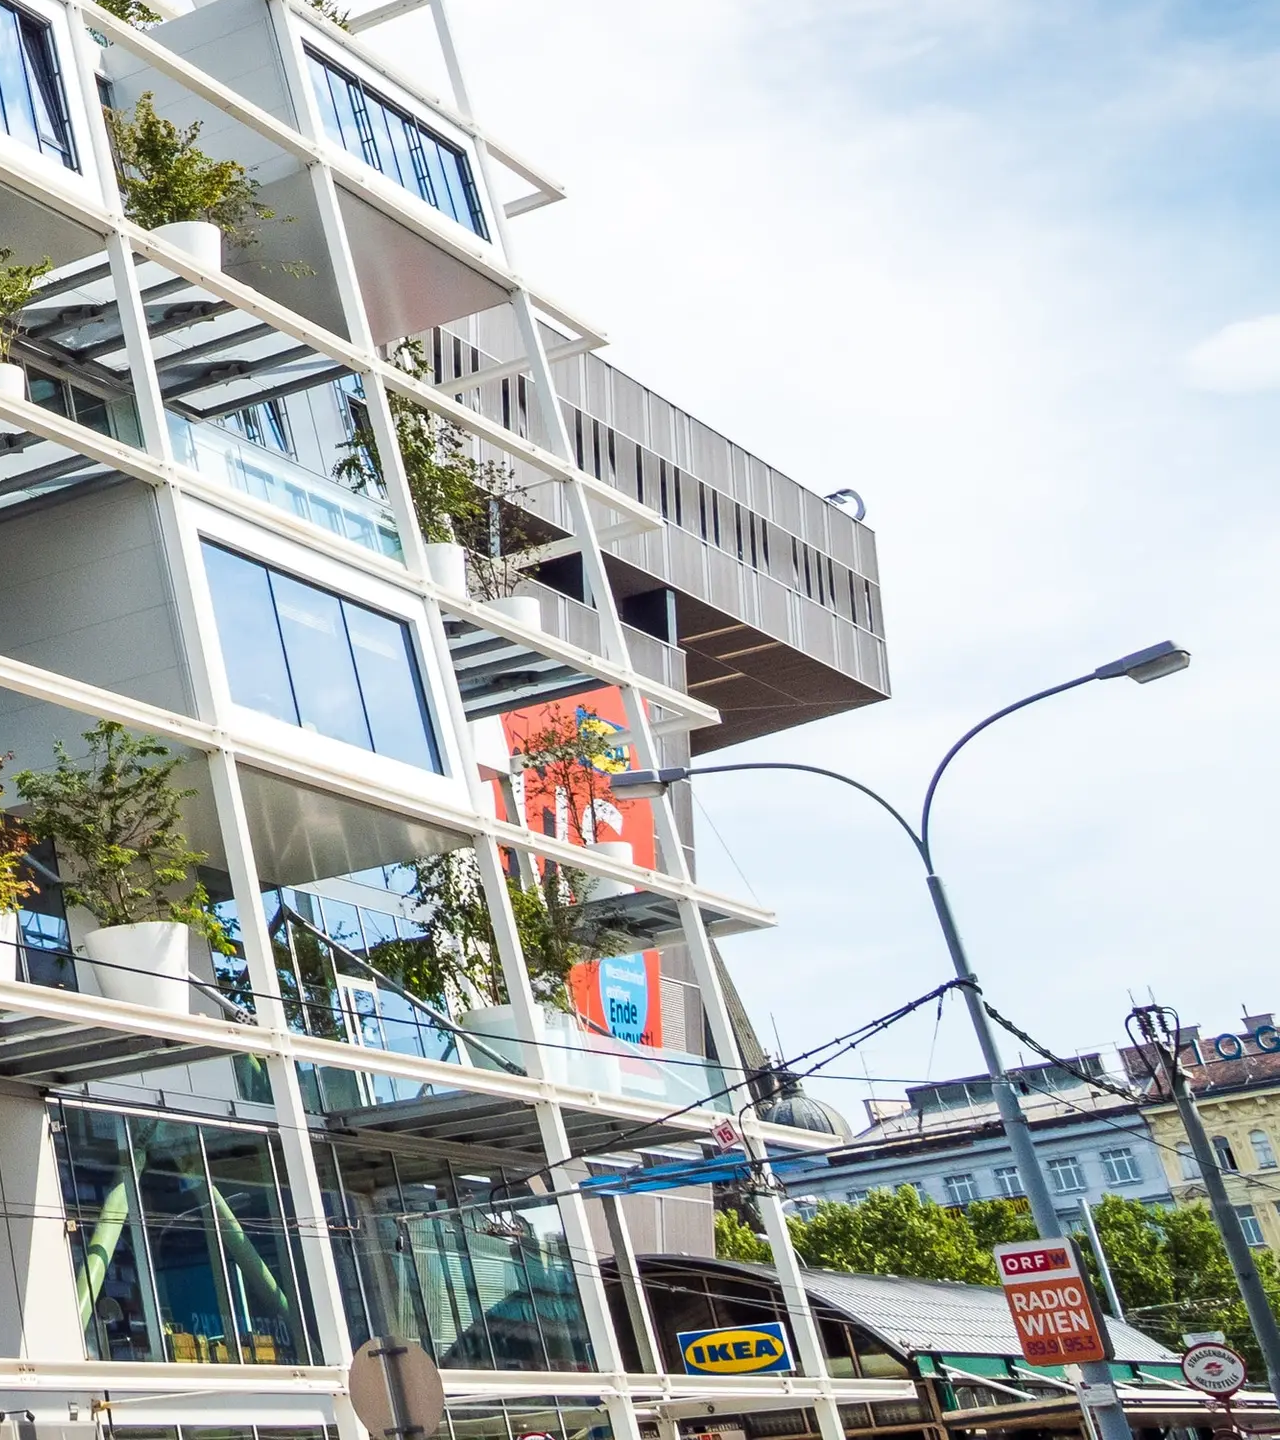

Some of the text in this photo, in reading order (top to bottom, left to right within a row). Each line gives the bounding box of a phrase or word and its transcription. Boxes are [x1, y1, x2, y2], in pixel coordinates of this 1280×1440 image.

[610, 998, 638, 1025] Ende
[717, 1127, 734, 1143] 15
[1005, 1255, 1045, 1271] ORF
[1011, 1286, 1082, 1312] RADIO
[1018, 1309, 1090, 1336] WIEN
[692, 1339, 778, 1363] IKEA
[1026, 1336, 1096, 1356] 89.9 95.3
[1187, 1349, 1237, 1369] STRASSENBAHN
[1194, 1372, 1240, 1390] HALTESTELLE
